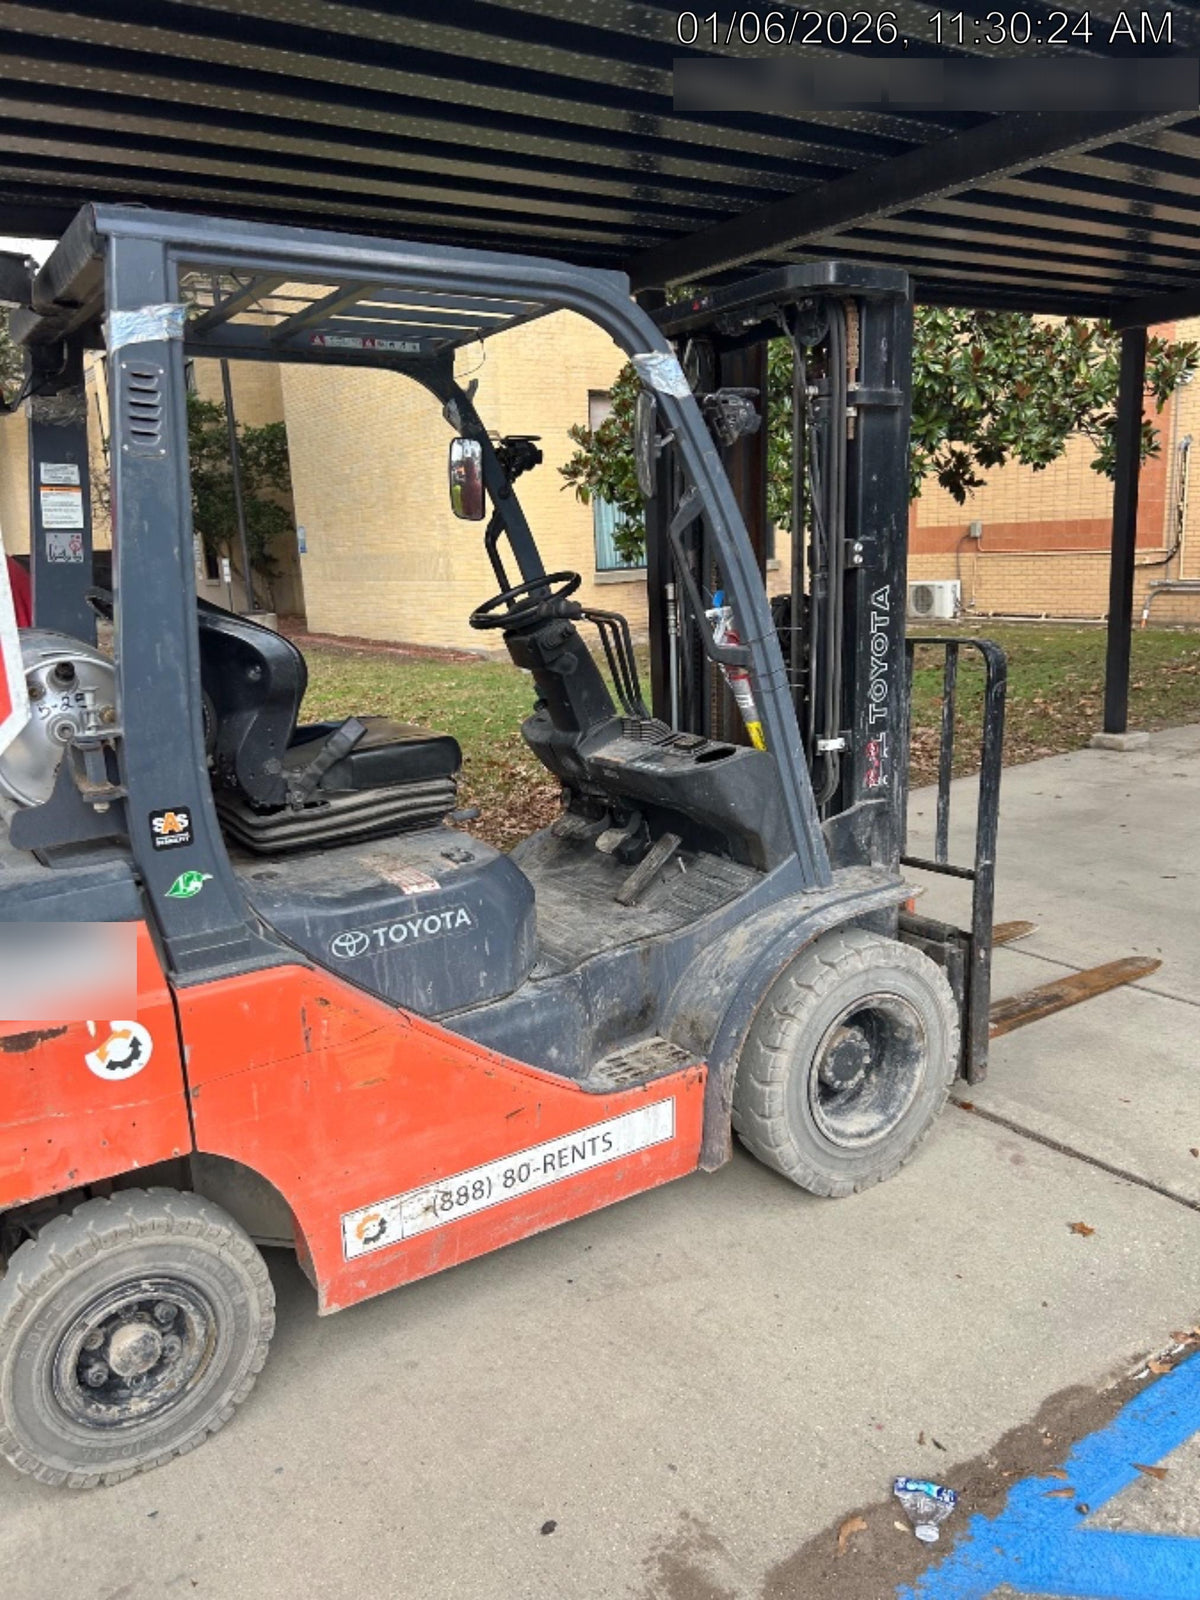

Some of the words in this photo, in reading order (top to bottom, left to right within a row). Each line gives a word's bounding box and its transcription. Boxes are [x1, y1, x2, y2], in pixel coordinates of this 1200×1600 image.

[869, 585, 890, 725] TOYOTA
[152, 811, 189, 835] SAS
[372, 907, 472, 947] TOYOTA
[431, 1176, 493, 1218] (888)
[502, 1131, 613, 1190] 80-RENTS
